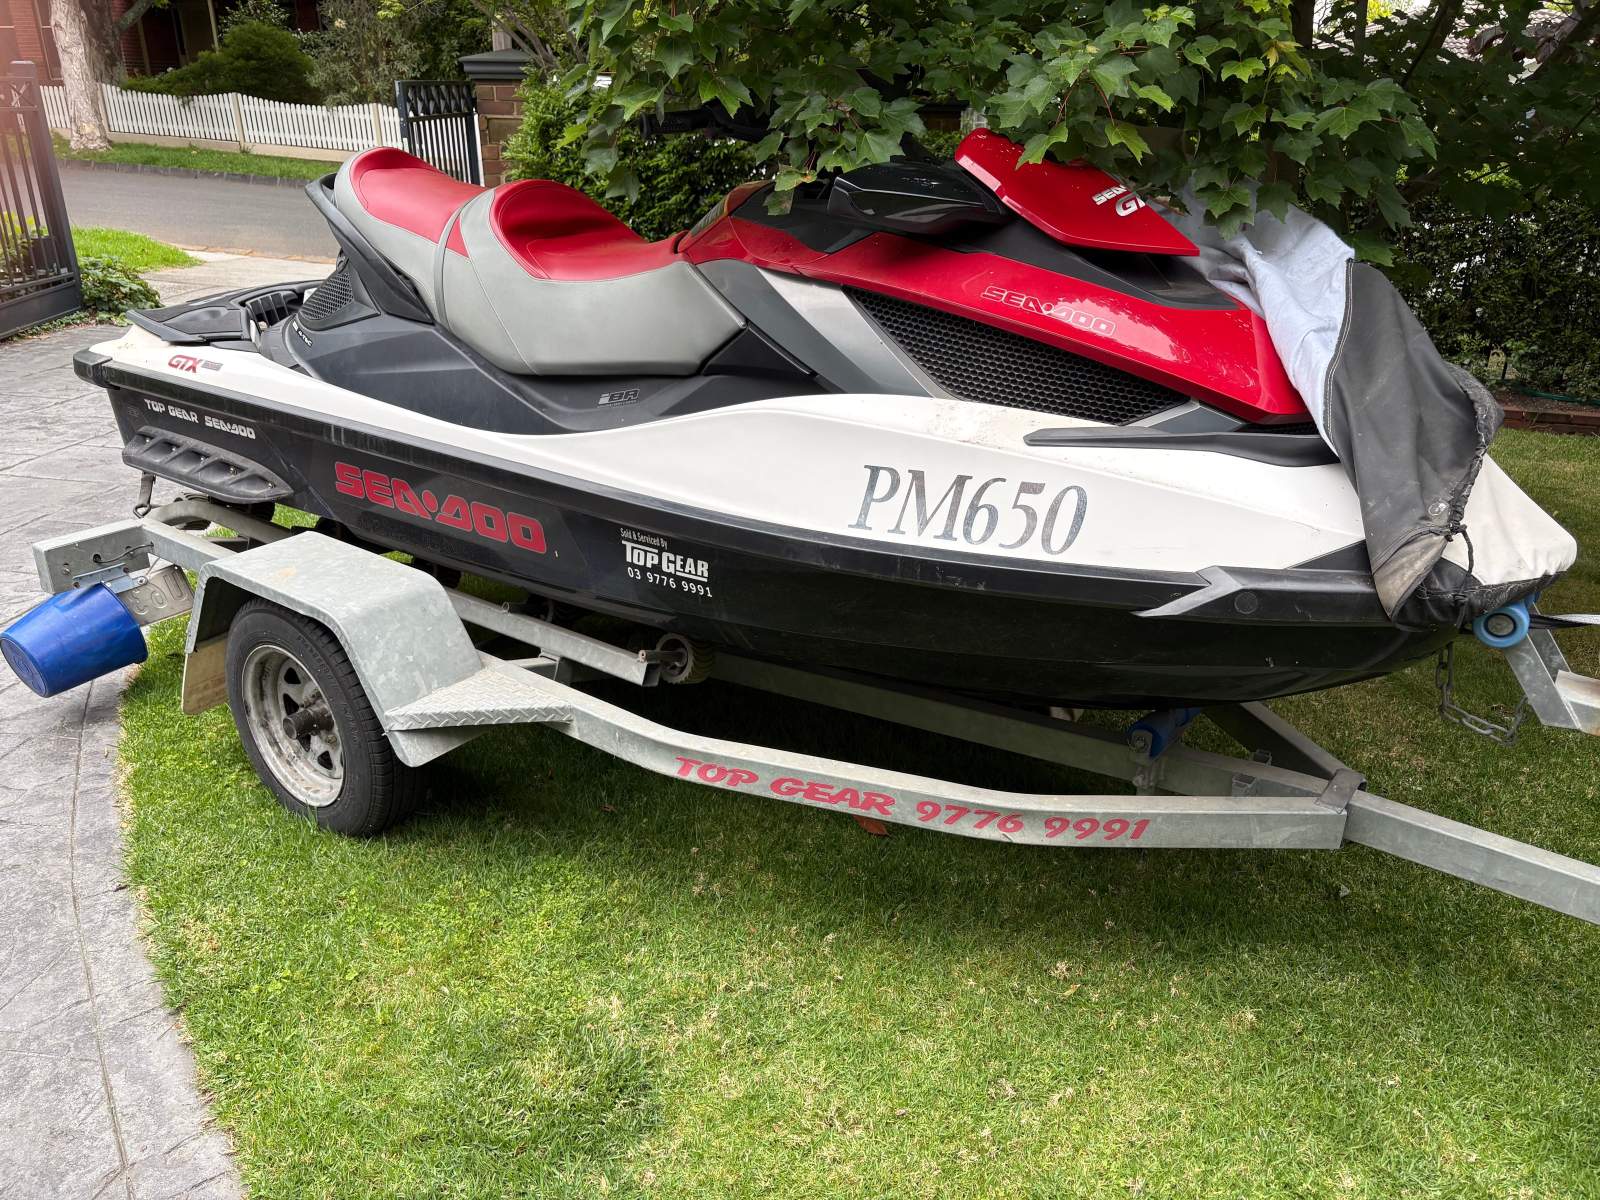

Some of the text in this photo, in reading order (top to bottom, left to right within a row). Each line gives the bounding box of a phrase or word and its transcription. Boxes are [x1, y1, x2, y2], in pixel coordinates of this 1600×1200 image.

[168, 354, 203, 374] GTX
[144, 398, 166, 414] TOP
[167, 405, 199, 424] GEAR
[848, 464, 1088, 556] PM650
[620, 527, 632, 540] Sold
[637, 532, 660, 547] Serviced
[660, 537, 668, 550] By
[621, 540, 709, 582] TOP GEAR
[627, 566, 713, 598] 03 9776 9991
[674, 755, 1153, 842] TOP GEAR 9776 9991
